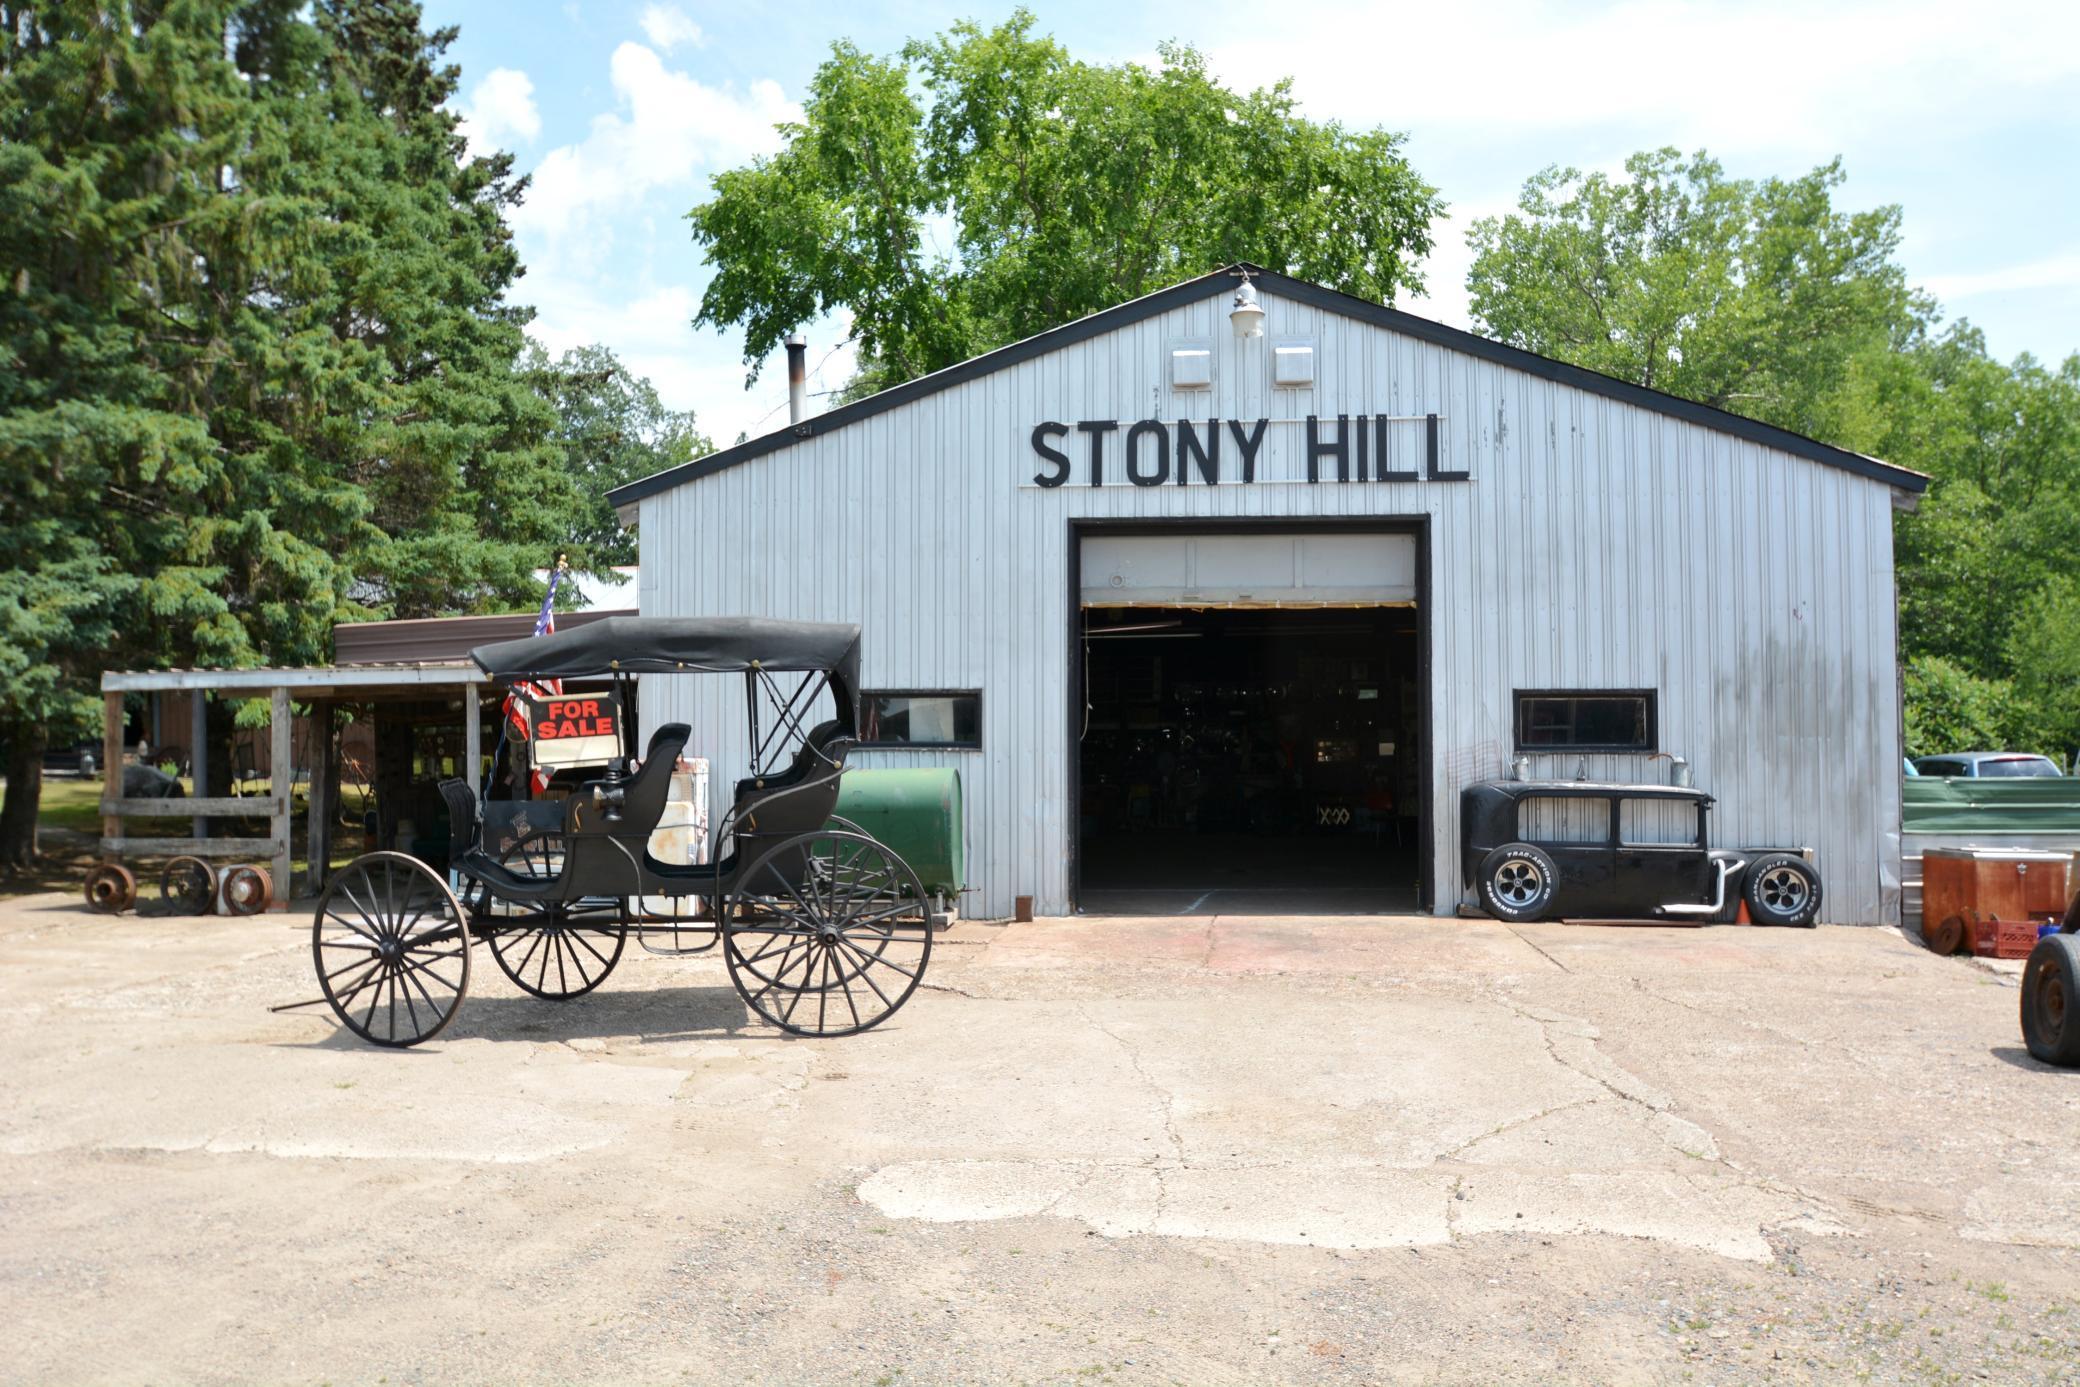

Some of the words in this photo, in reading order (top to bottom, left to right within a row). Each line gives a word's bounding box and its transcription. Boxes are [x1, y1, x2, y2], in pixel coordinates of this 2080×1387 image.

[1031, 418, 1269, 487] STONY
[1306, 413, 1470, 484] HILL
[548, 700, 599, 720] FOR
[537, 717, 613, 739] SALE
